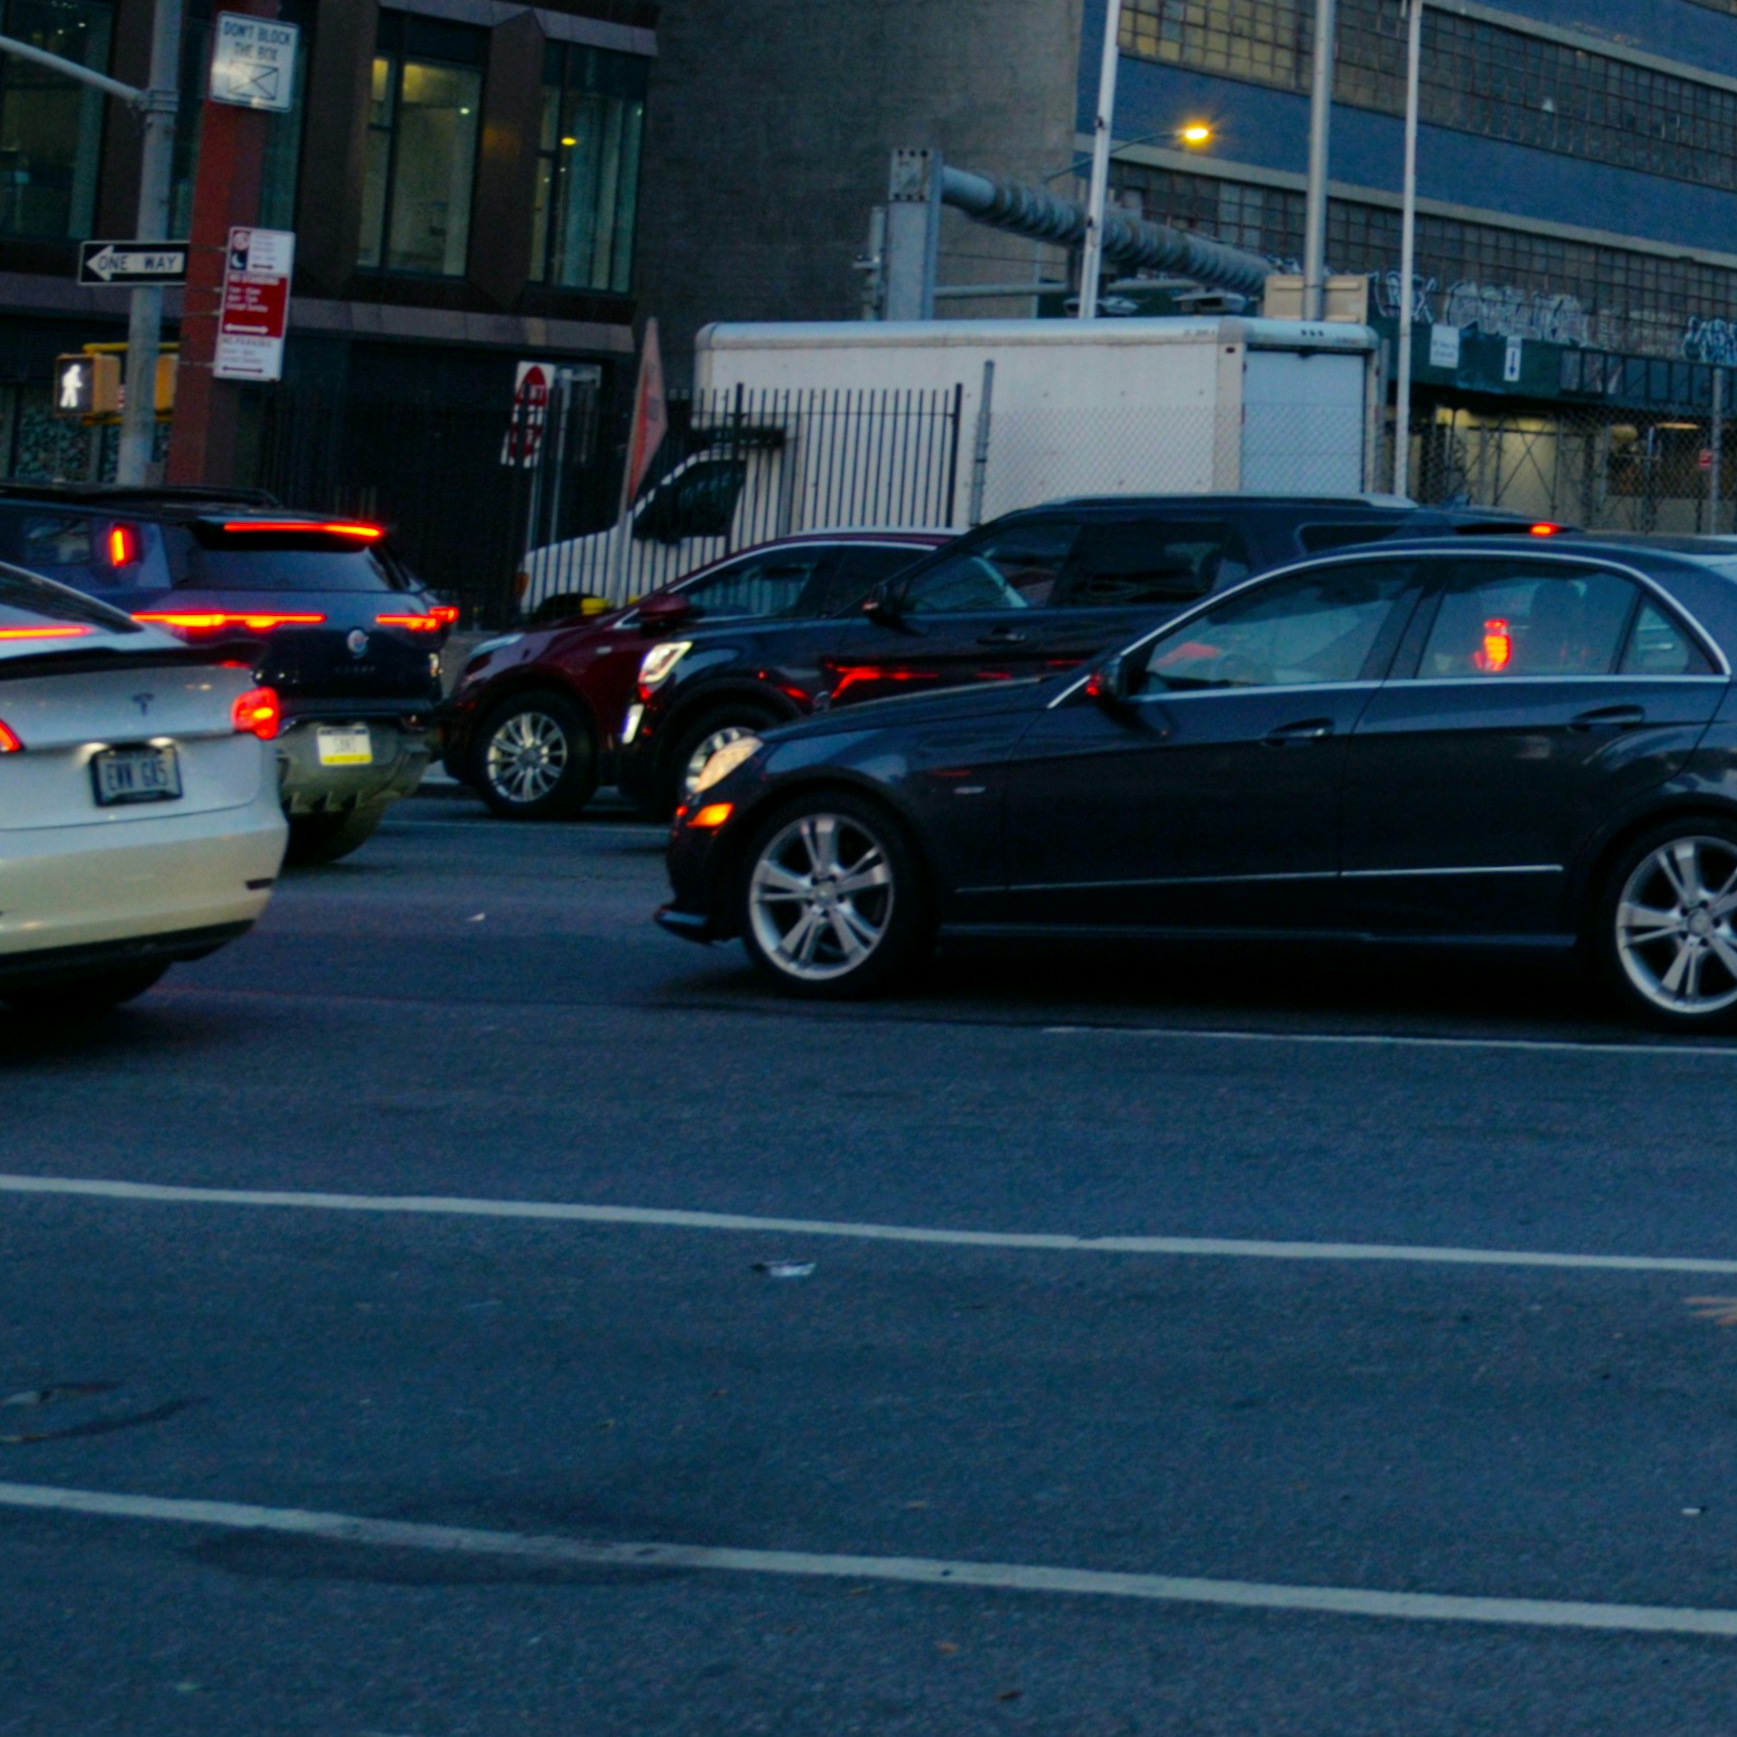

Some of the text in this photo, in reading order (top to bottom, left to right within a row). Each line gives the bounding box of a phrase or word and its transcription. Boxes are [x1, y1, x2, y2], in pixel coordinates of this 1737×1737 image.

[257, 27, 292, 45] BLOCK
[98, 254, 177, 272] ONE WAY
